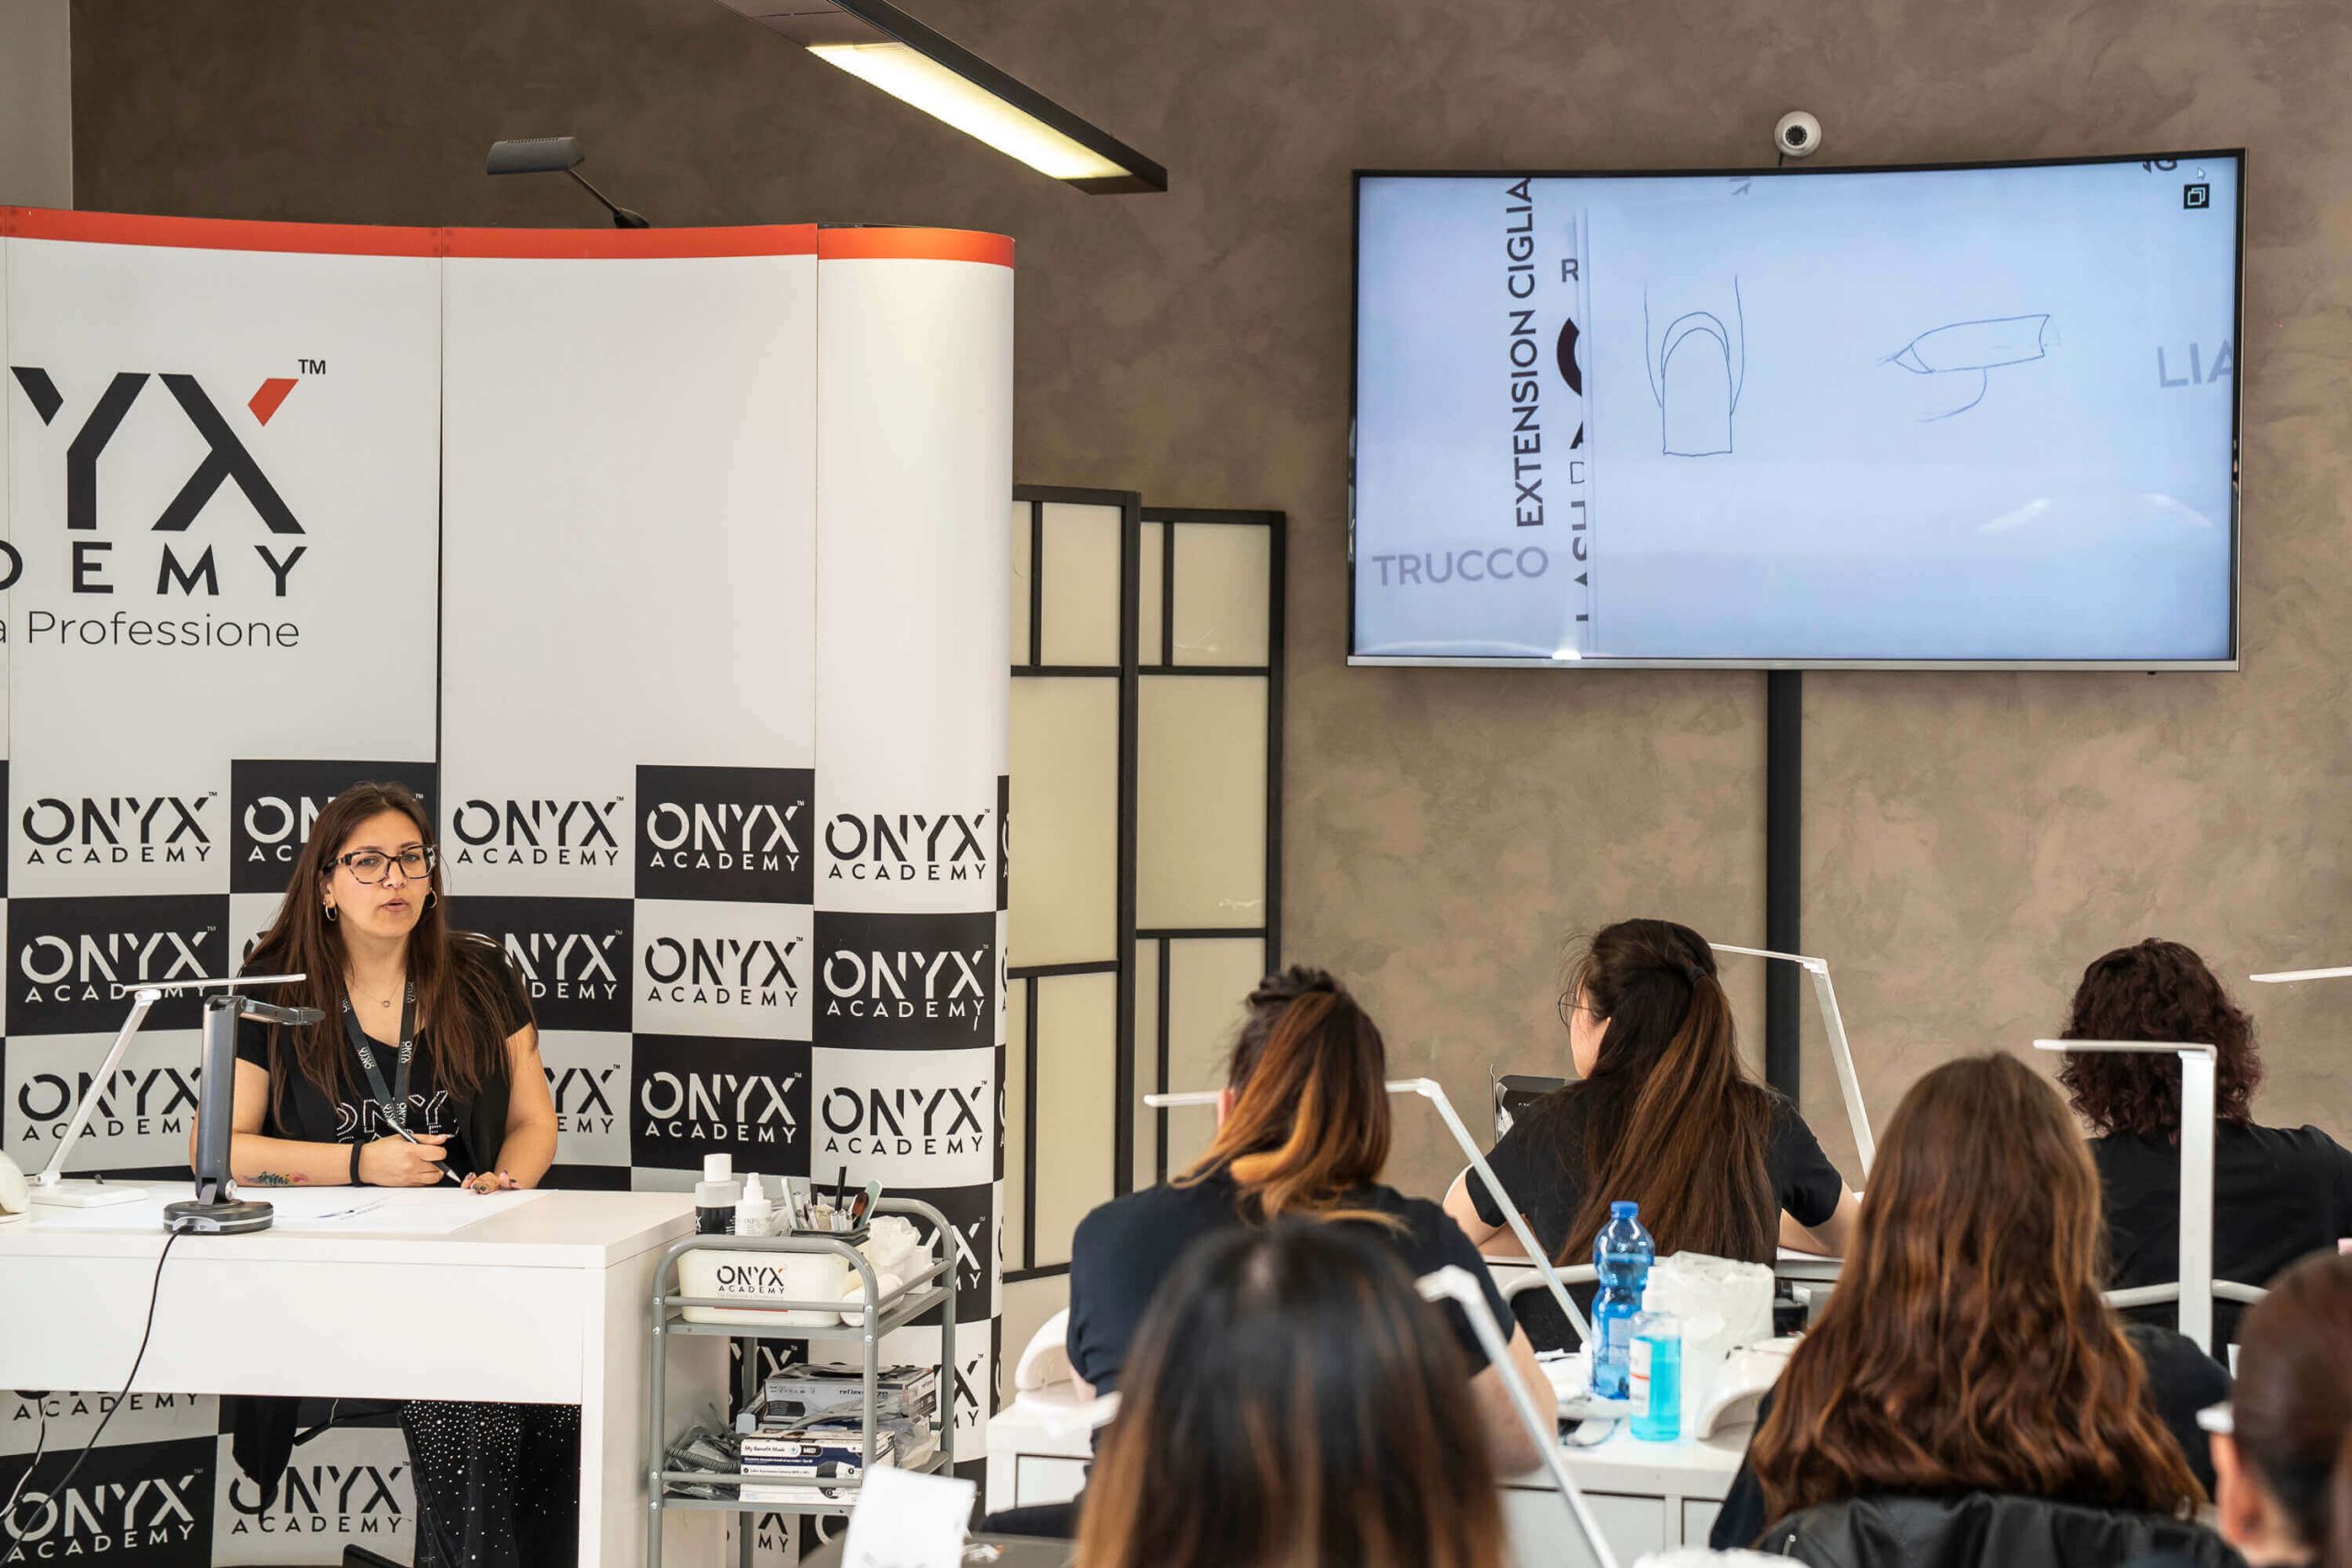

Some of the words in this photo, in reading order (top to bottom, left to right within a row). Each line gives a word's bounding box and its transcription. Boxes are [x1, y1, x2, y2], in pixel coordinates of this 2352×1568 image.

[1507, 177, 1535, 299] CIGLIA
[1510, 310, 1544, 527] EXTENSION
[1373, 546, 1549, 587] TRUCCO
[28, 610, 300, 647] Professione
[22, 796, 210, 846] ONYX
[453, 799, 619, 847] ONYX
[646, 802, 799, 853] ONYX
[825, 813, 986, 862] ONYX
[27, 845, 211, 864] ACADEMY
[457, 848, 618, 865] ACADEMY
[650, 852, 800, 872] ACADEMY
[829, 863, 986, 880] ACADEMY
[21, 931, 209, 984] ONYX
[504, 933, 616, 980] NYX
[644, 937, 797, 988] ONYX
[823, 950, 985, 998] ONYX
[648, 987, 798, 1008] ACADEMY
[827, 999, 985, 1018] ACADEMY
[641, 1071, 797, 1125] ONYX
[822, 1086, 983, 1136] ONYX
[22, 1118, 195, 1141] ACADEM
[645, 1121, 797, 1144] ACADEMY
[825, 1135, 984, 1155] ACADEMY
[718, 1266, 785, 1286] ONYX
[718, 1285, 785, 1294] ACADEMY
[13, 1393, 198, 1421] ACADEMY
[5, 1475, 195, 1541] ONYX
[232, 1516, 401, 1534] ACADEMY
[7, 1524, 195, 1562] ACADEMY
